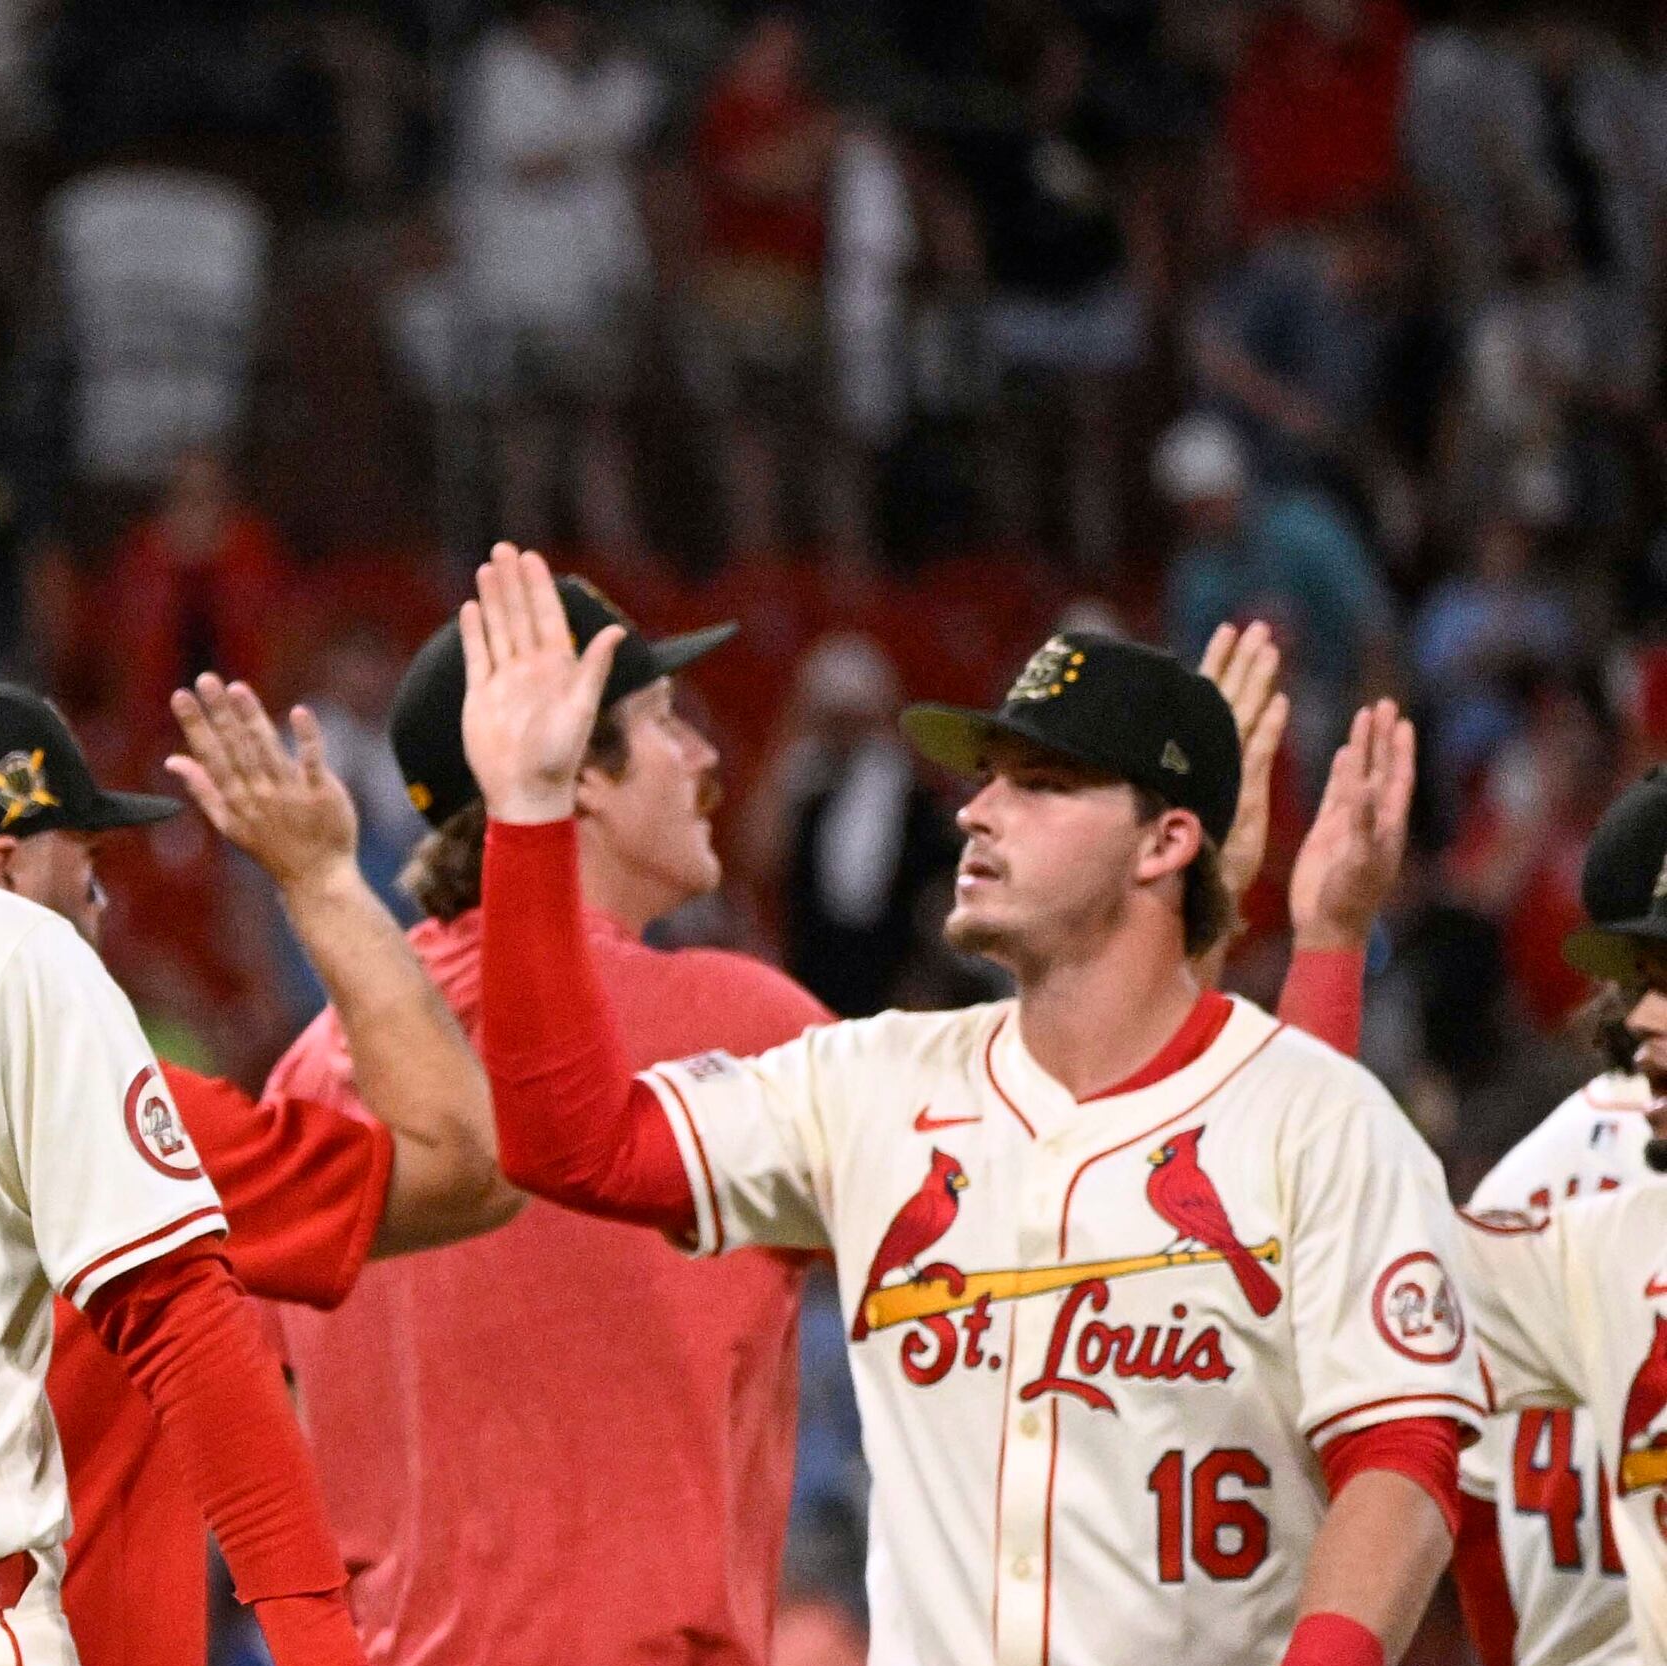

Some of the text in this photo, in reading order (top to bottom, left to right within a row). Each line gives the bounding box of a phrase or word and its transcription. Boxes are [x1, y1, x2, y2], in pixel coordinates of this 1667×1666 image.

[901, 1262, 1235, 1415] St. Louis
[1147, 1447, 1272, 1584] 16
